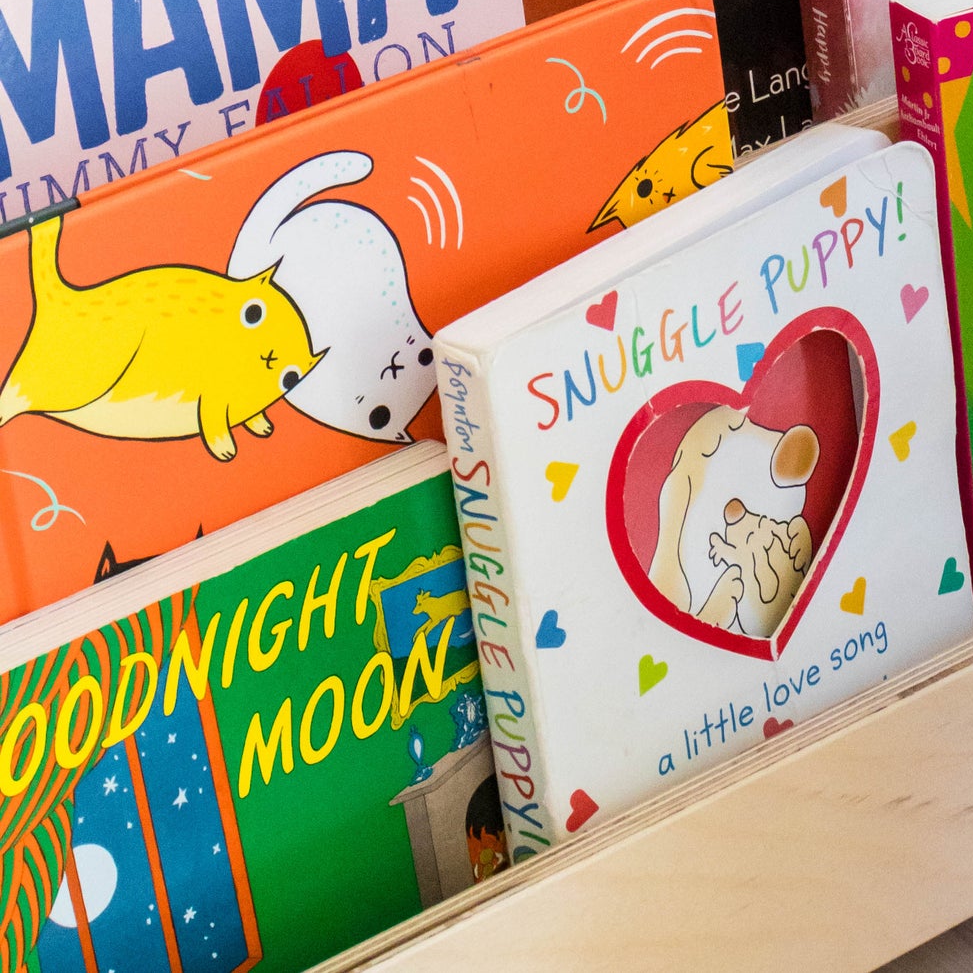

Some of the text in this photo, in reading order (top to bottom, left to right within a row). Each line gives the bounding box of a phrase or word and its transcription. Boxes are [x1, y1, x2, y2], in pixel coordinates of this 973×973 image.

[811, 10, 832, 86] Happy
[527, 180, 908, 432] SNUGGLE PUPPY!
[0, 528, 397, 798] OODNIGHT
[451, 457, 515, 682] SNUGGLE
[238, 617, 456, 800] MOON
[658, 620, 889, 776] a little love song
